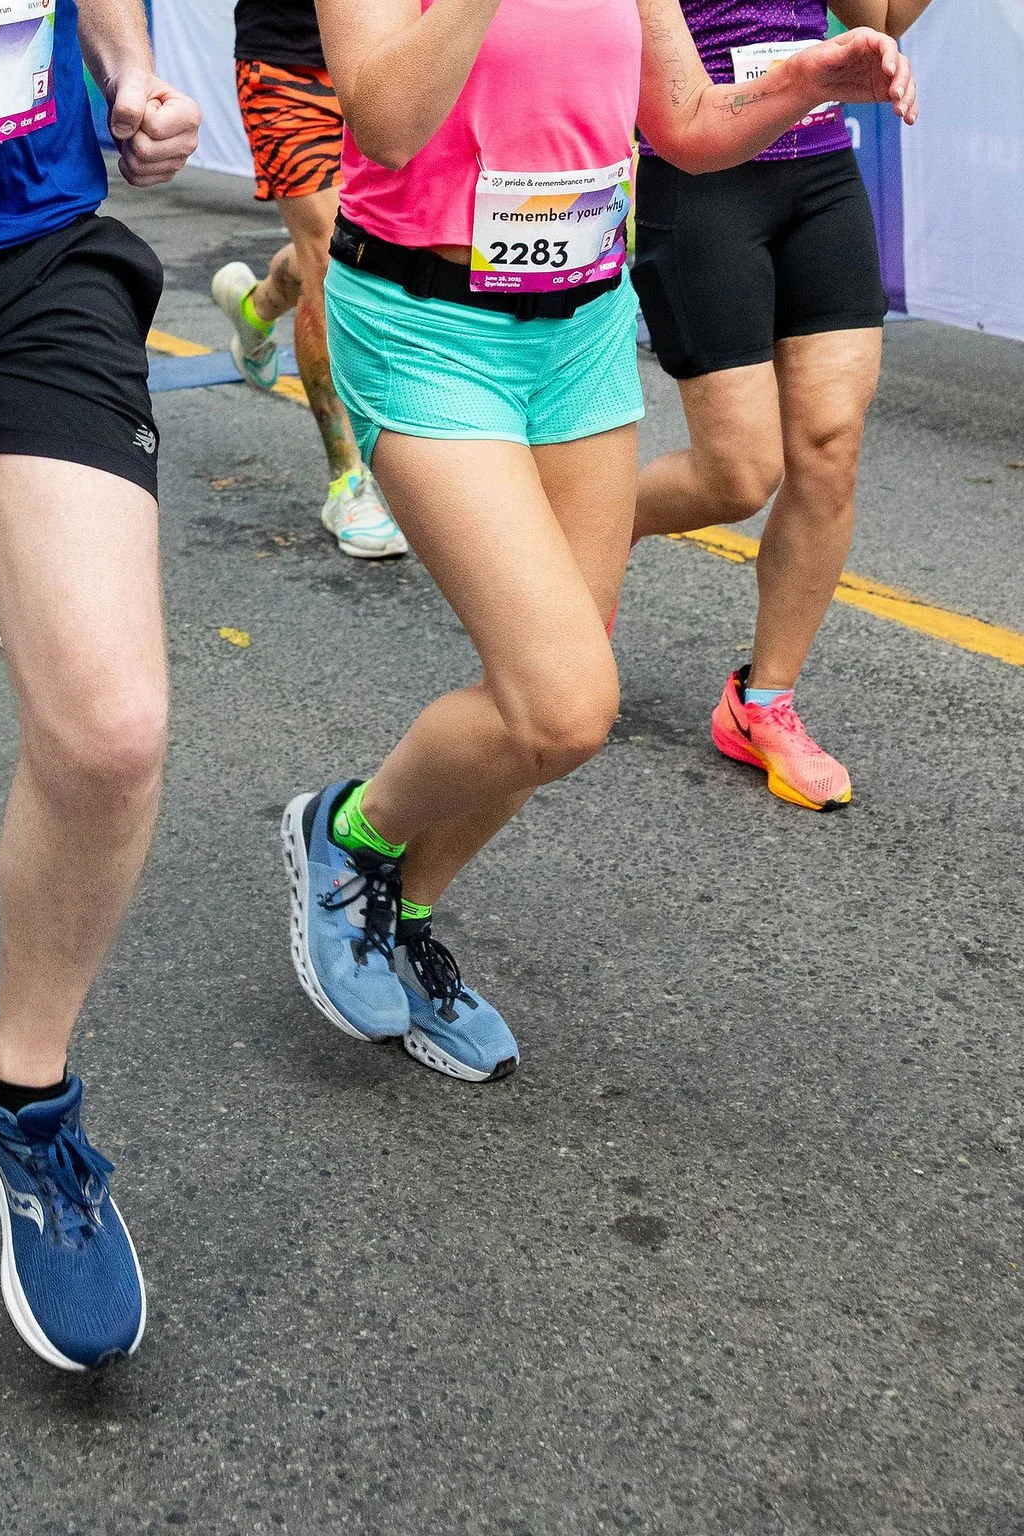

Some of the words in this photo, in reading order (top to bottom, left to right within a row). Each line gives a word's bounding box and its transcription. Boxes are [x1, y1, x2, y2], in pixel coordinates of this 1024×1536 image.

[0, 6, 12, 15] run
[37, 79, 44, 94] 2
[504, 179, 525, 188] pride
[527, 179, 533, 187] &
[534, 177, 582, 187] remembrance
[492, 208, 573, 222] remember
[577, 206, 603, 223] your
[606, 197, 624, 212] why
[488, 239, 569, 268] 2283
[603, 236, 611, 248] 2
